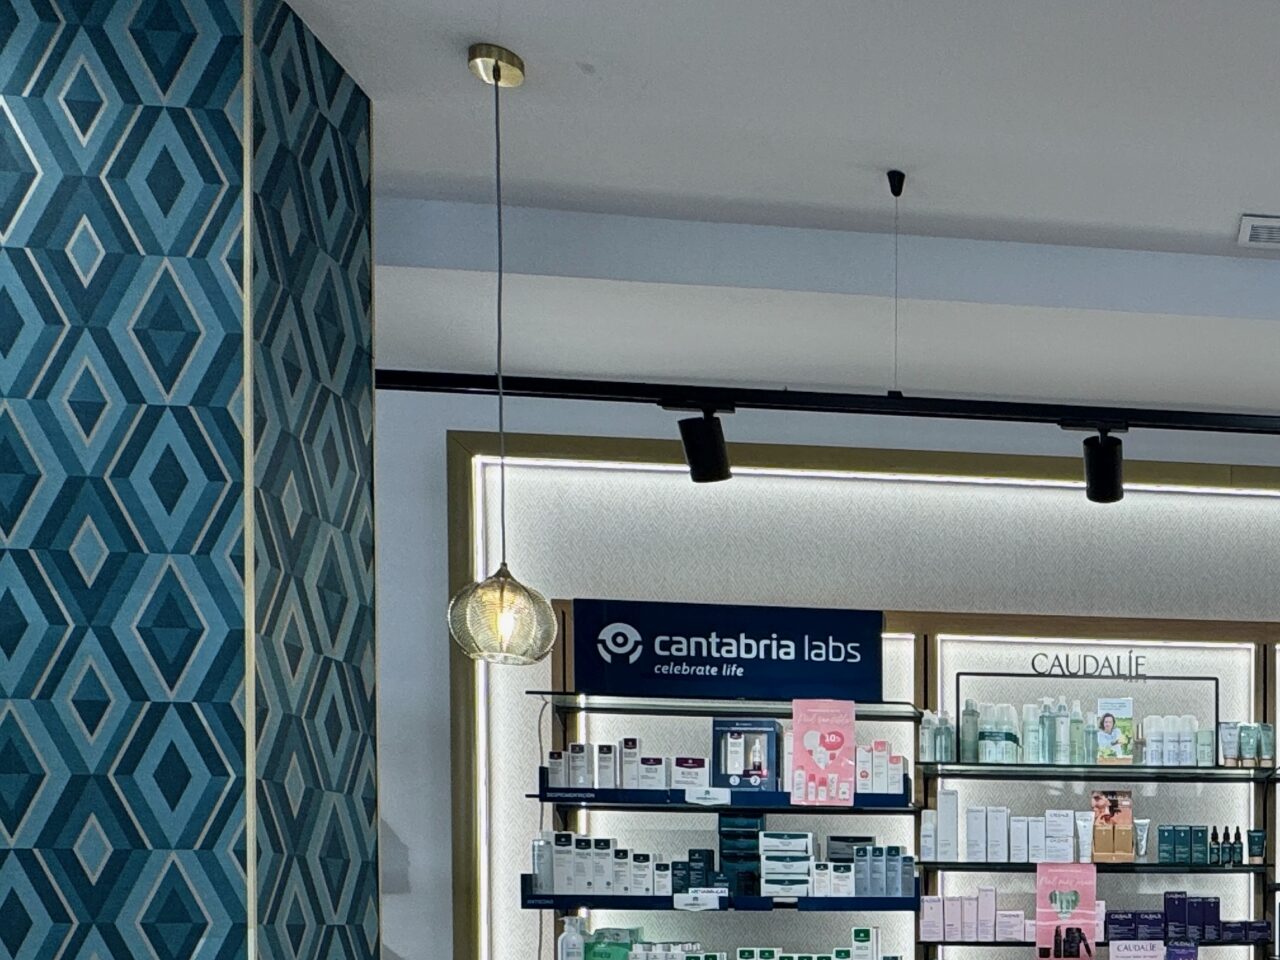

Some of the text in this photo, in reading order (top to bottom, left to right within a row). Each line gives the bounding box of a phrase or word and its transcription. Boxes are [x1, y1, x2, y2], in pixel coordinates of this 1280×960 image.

[654, 632, 861, 662] cantabria labs
[654, 662, 744, 676] celebrate life
